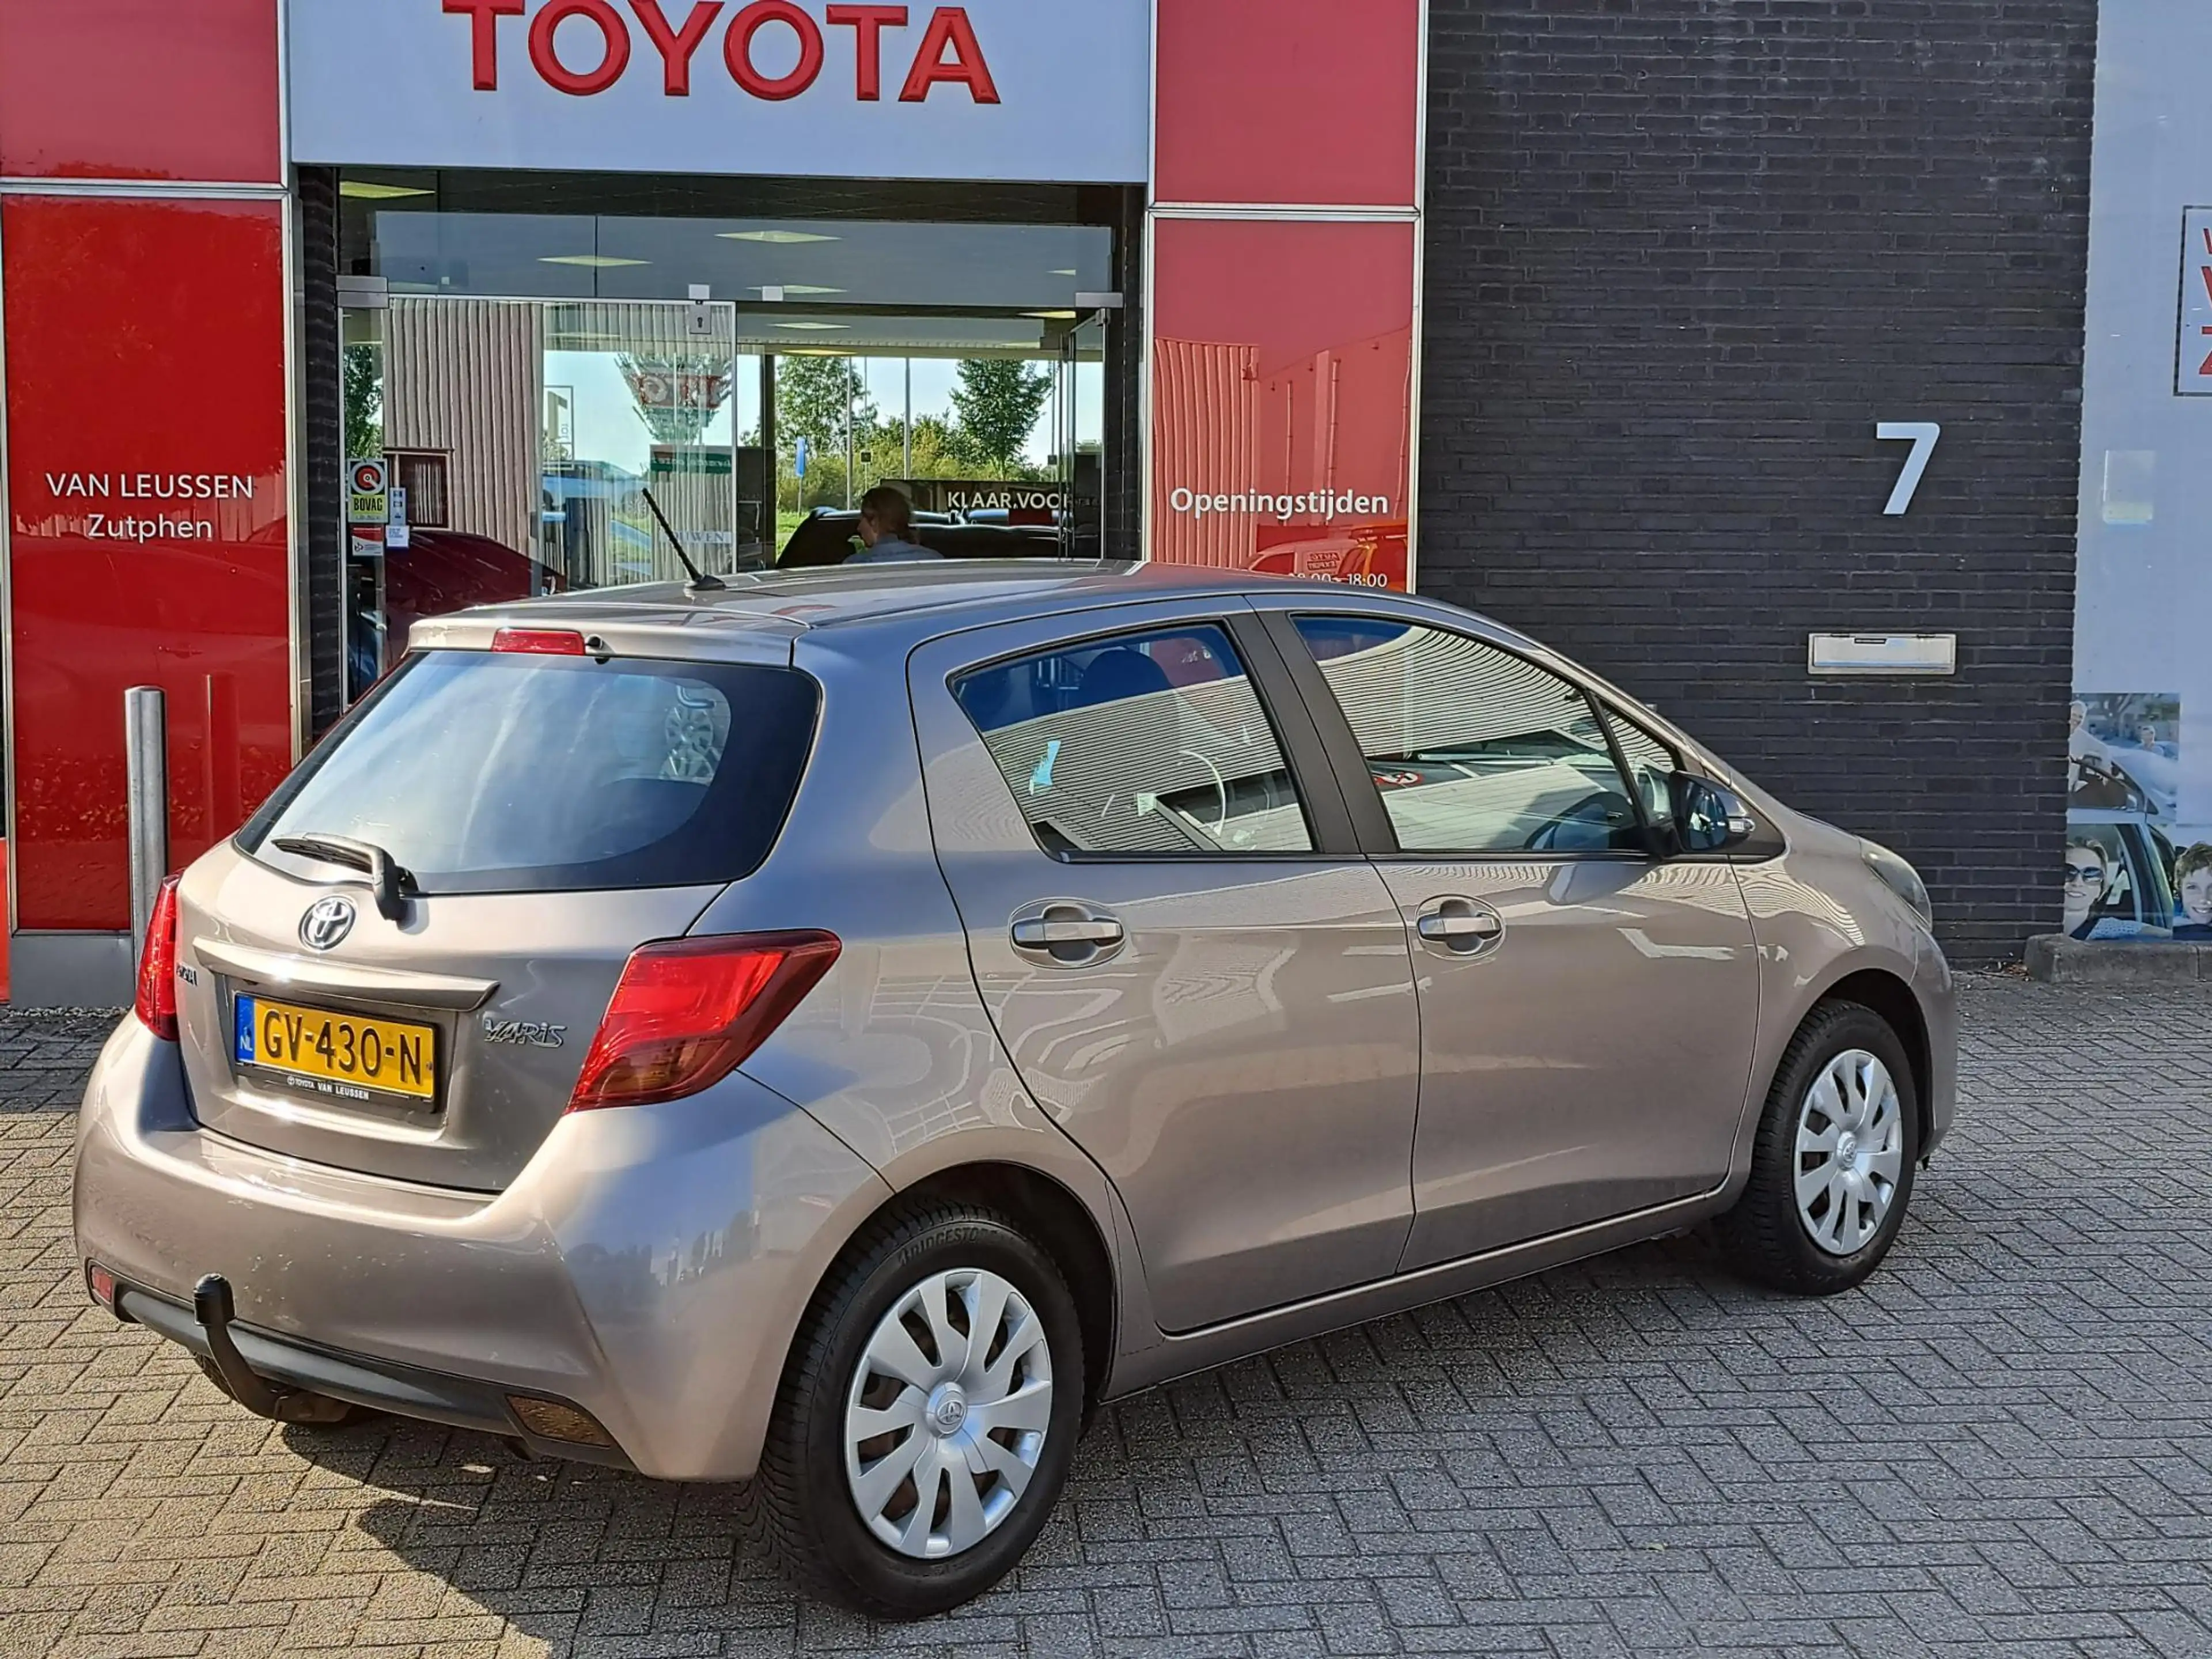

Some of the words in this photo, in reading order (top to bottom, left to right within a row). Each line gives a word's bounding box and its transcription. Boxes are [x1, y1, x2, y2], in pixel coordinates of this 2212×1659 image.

[442, 0, 1001, 104] TOYOTA
[1876, 422, 1941, 515] 7
[46, 472, 109, 498] VAN
[120, 473, 253, 498] LEUSSEN
[354, 497, 383, 512] BOVAG
[947, 491, 1012, 509] KLAAR
[1170, 487, 1389, 520] Openingstijden
[87, 513, 213, 543] Zutphen
[239, 1035, 253, 1052] NL
[263, 1009, 422, 1086] GV-430-N
[294, 1078, 315, 1089] TOYOTA
[317, 1082, 333, 1093] VAN
[335, 1085, 369, 1100] LEUSSEN
